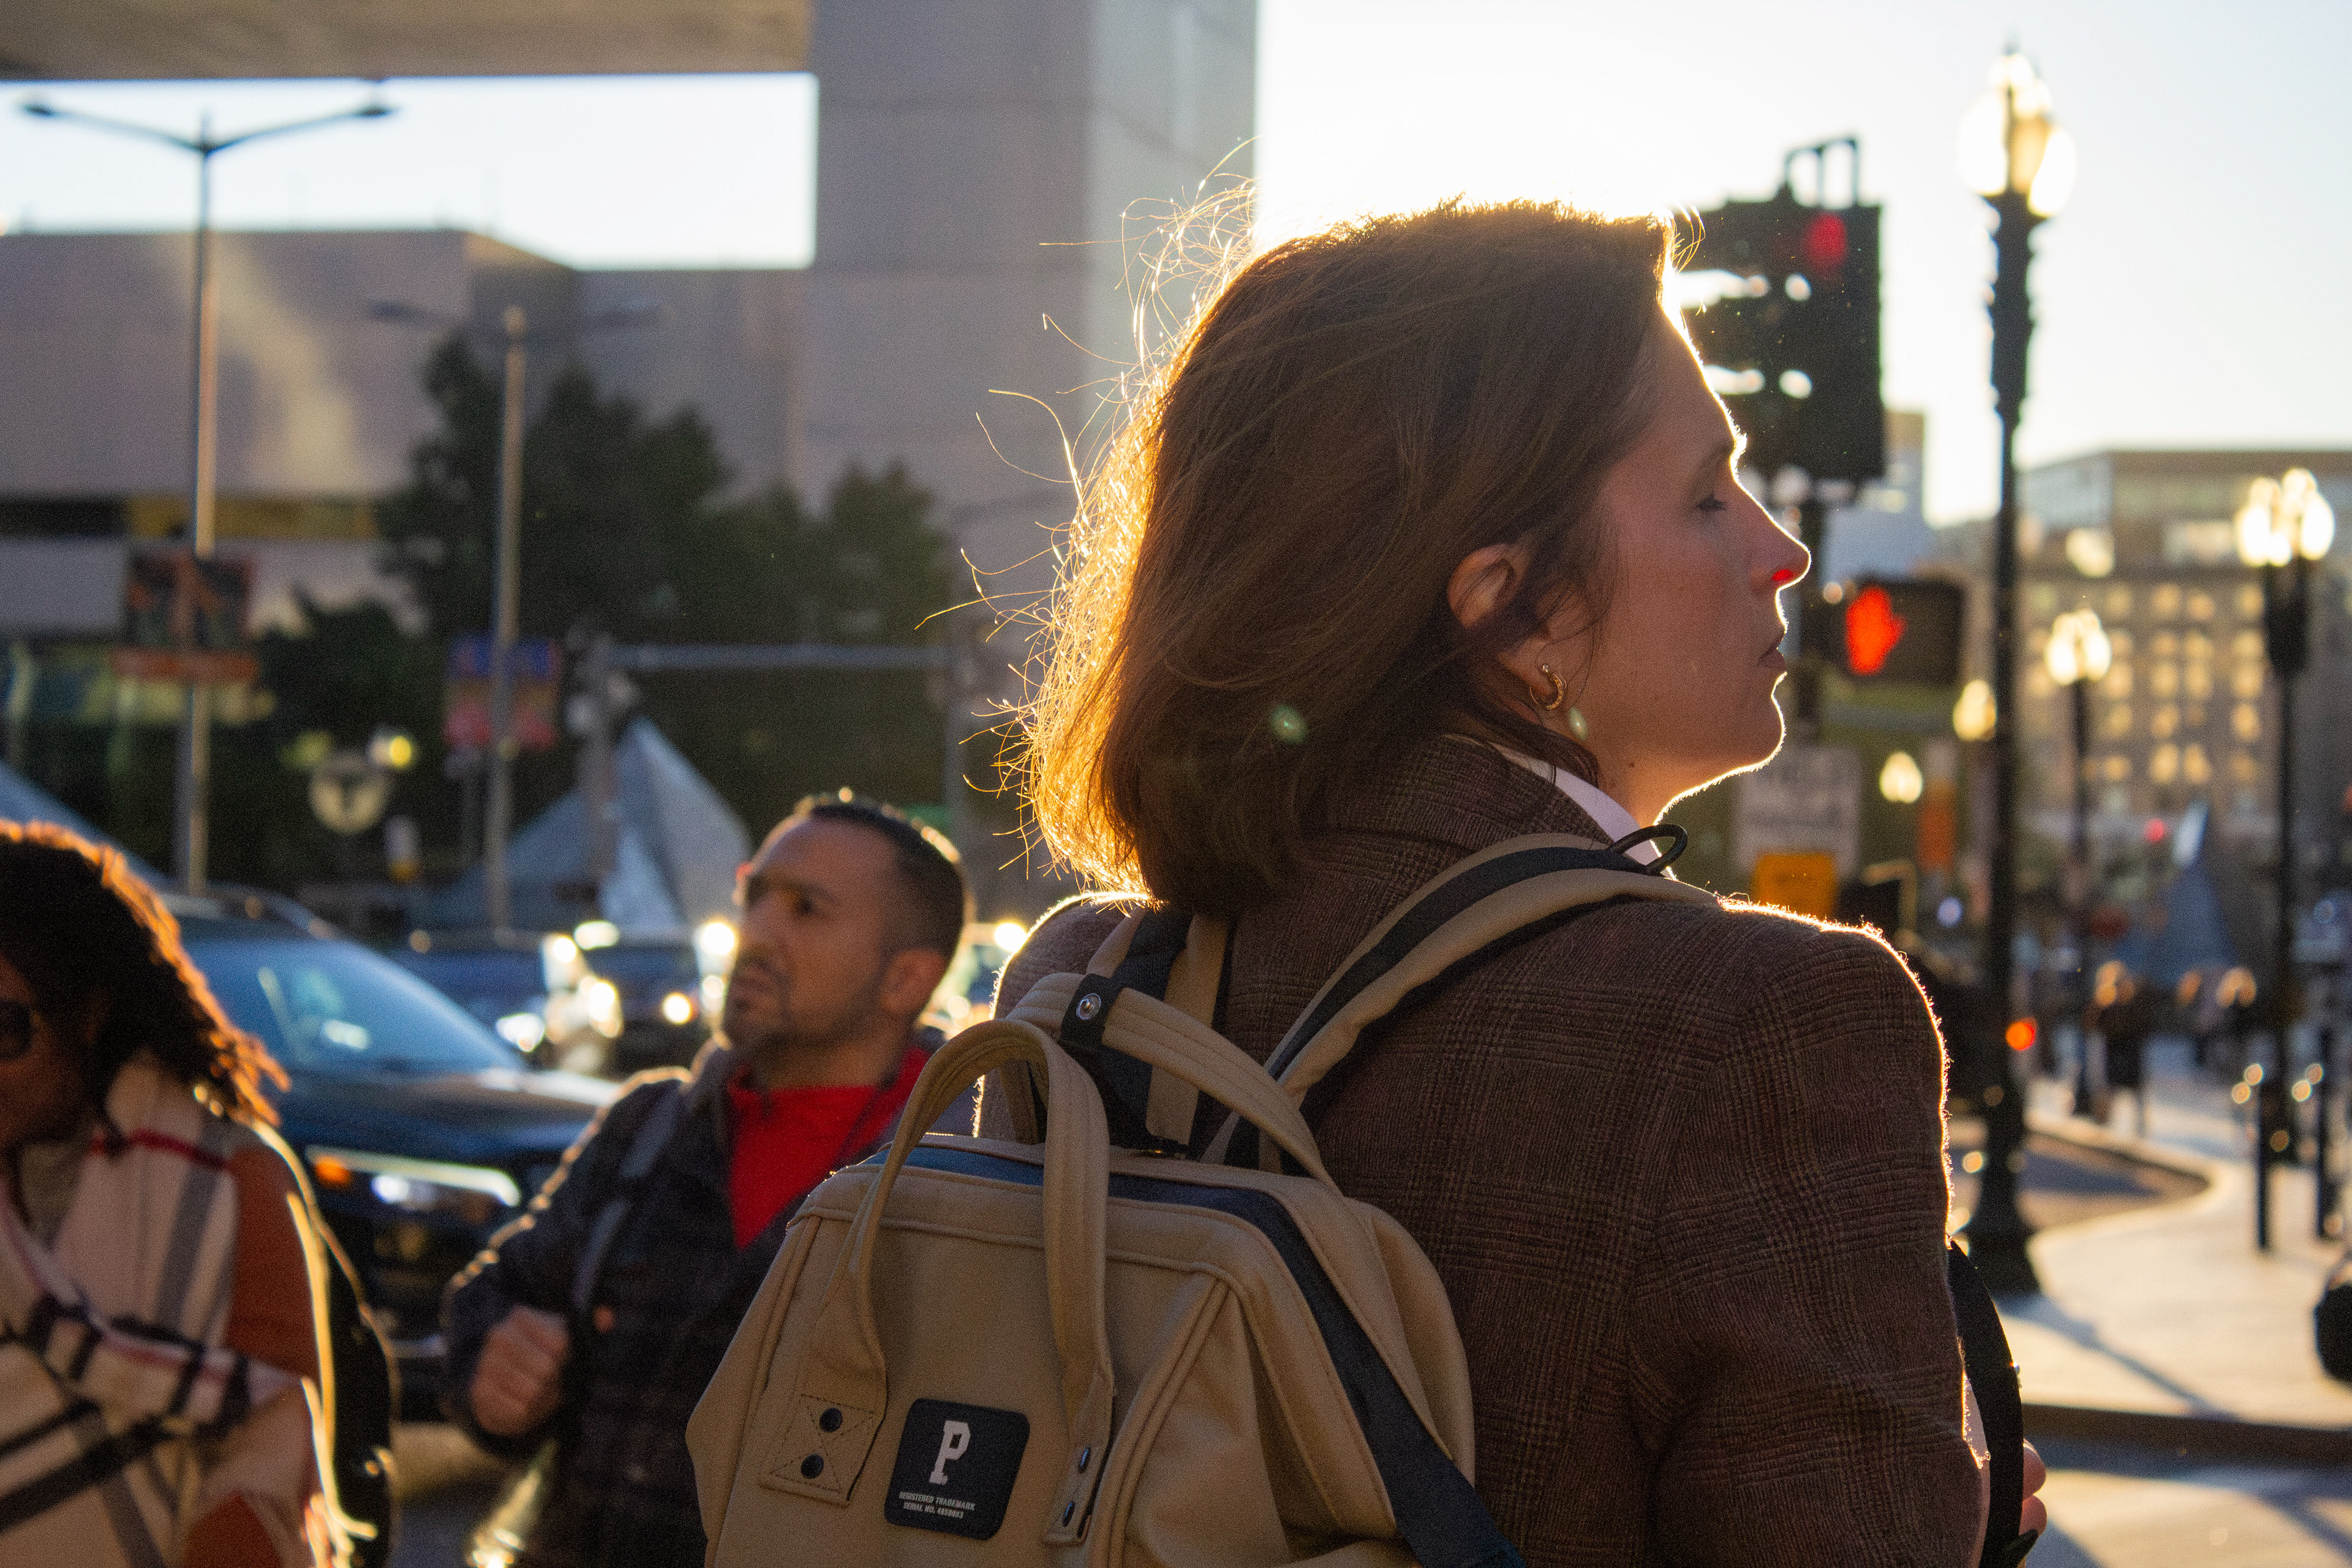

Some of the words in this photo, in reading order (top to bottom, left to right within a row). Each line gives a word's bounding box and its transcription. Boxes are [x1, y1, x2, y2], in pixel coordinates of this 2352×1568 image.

[929, 1420, 971, 1483] P
[899, 1491, 935, 1504] REGISTERED
[935, 1497, 976, 1511] TRADEMARK
[903, 1502, 923, 1512] SERIAL
